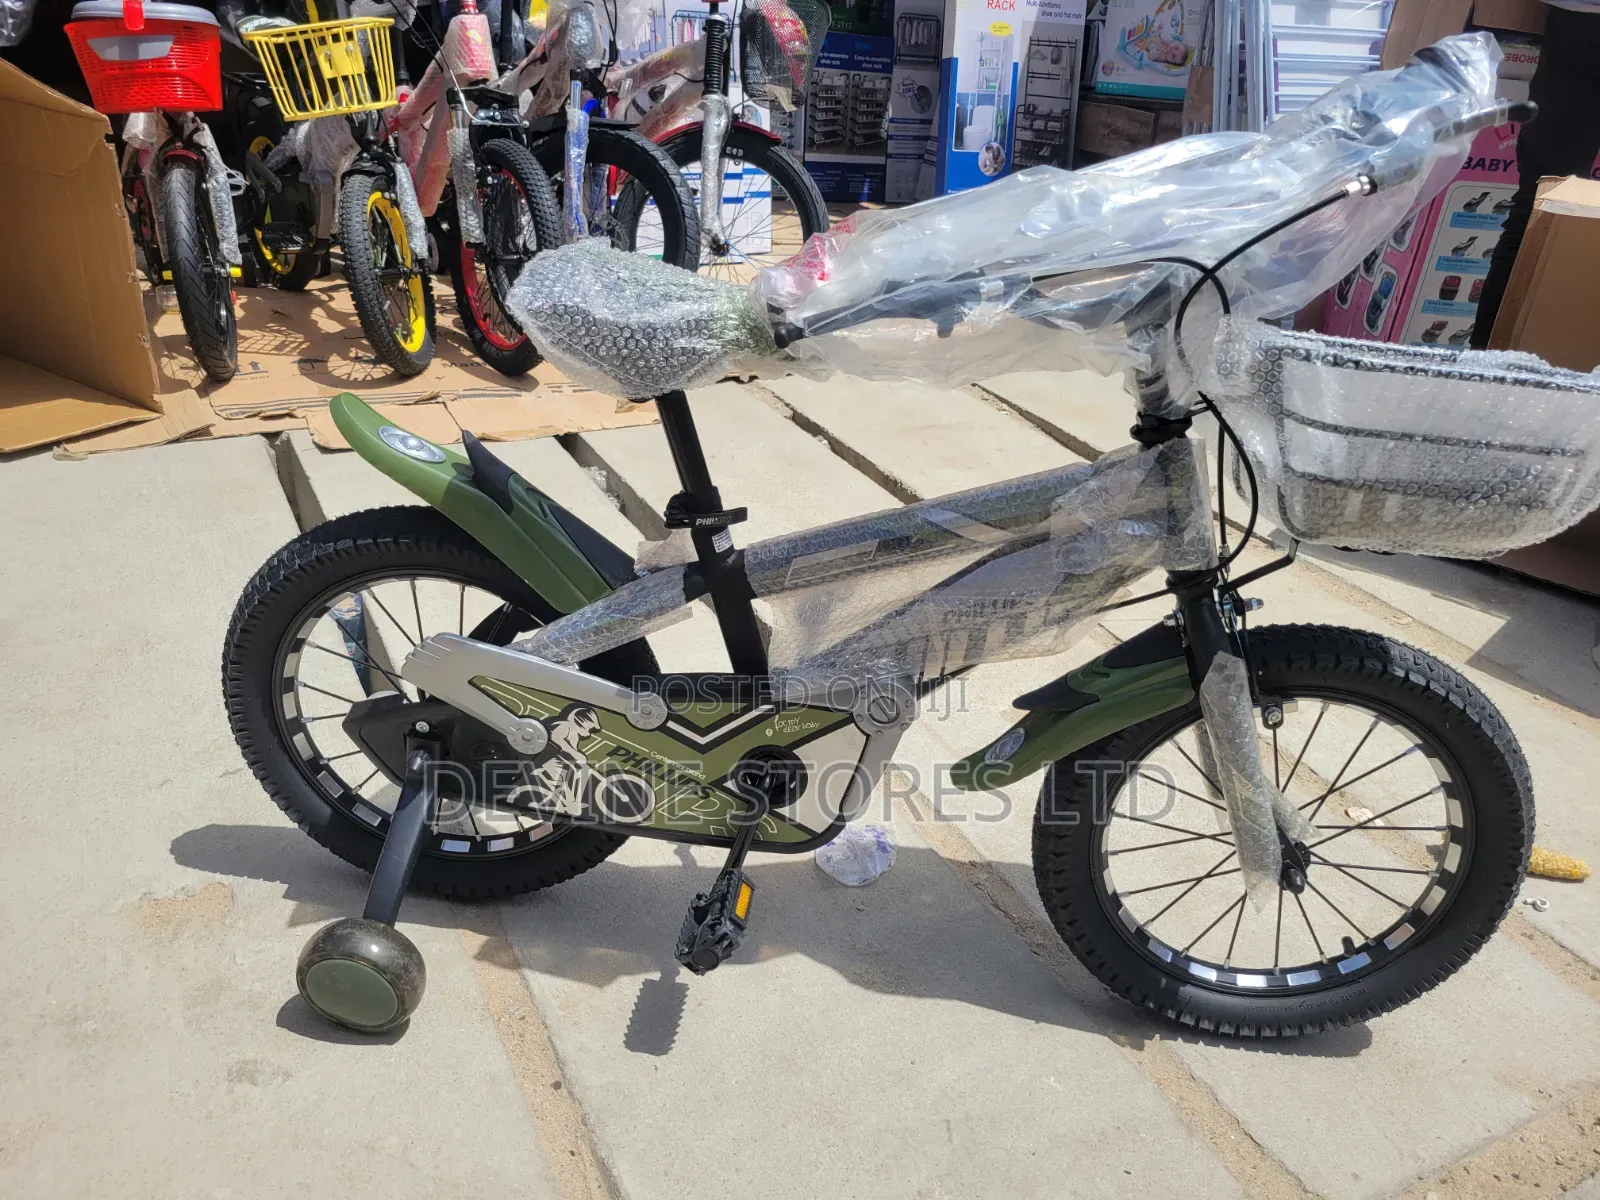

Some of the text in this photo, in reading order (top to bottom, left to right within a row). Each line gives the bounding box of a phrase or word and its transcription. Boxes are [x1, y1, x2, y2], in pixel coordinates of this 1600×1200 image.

[987, 0, 1015, 11] RACK
[1504, 53, 1540, 65] DROBE
[1461, 157, 1514, 173] BABY
